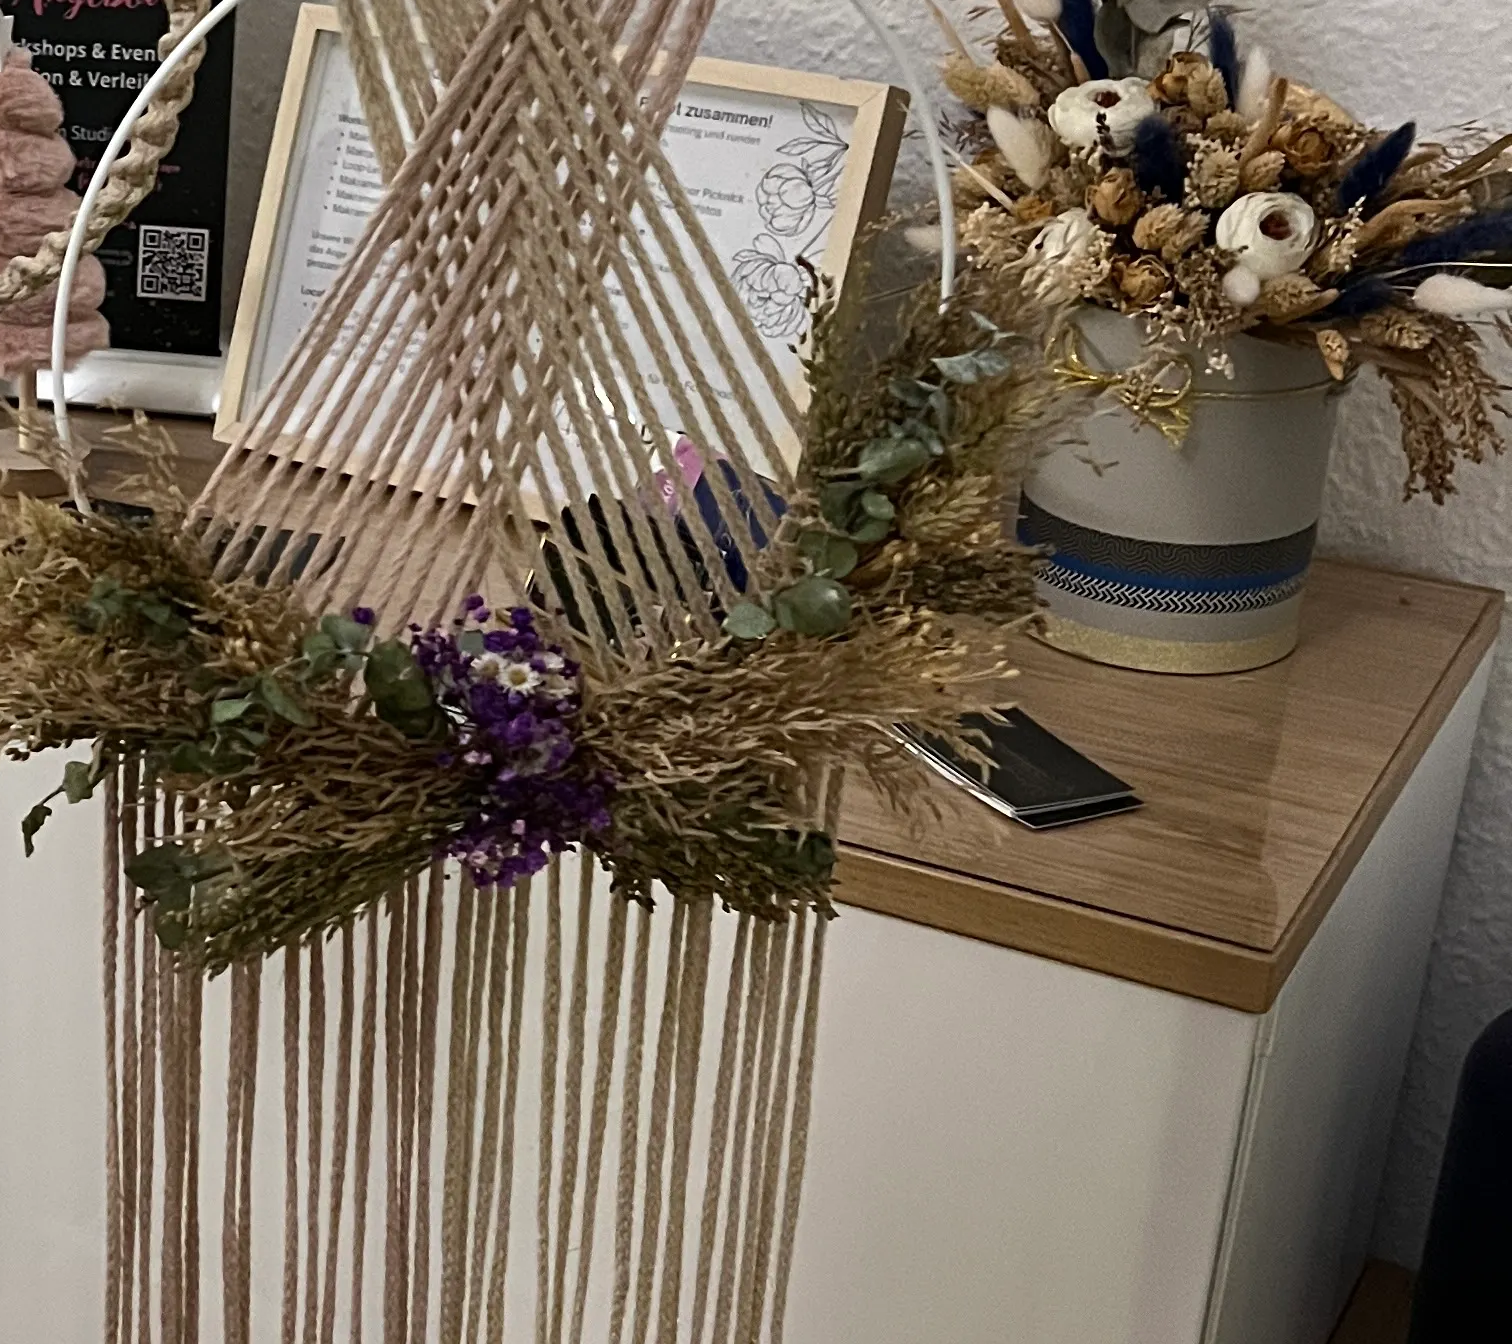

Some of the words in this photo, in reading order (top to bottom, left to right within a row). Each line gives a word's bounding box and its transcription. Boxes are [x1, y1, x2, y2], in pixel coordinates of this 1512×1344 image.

[91, 43, 107, 59] &
[69, 69, 83, 87] &
[685, 105, 774, 129] zusammen!
